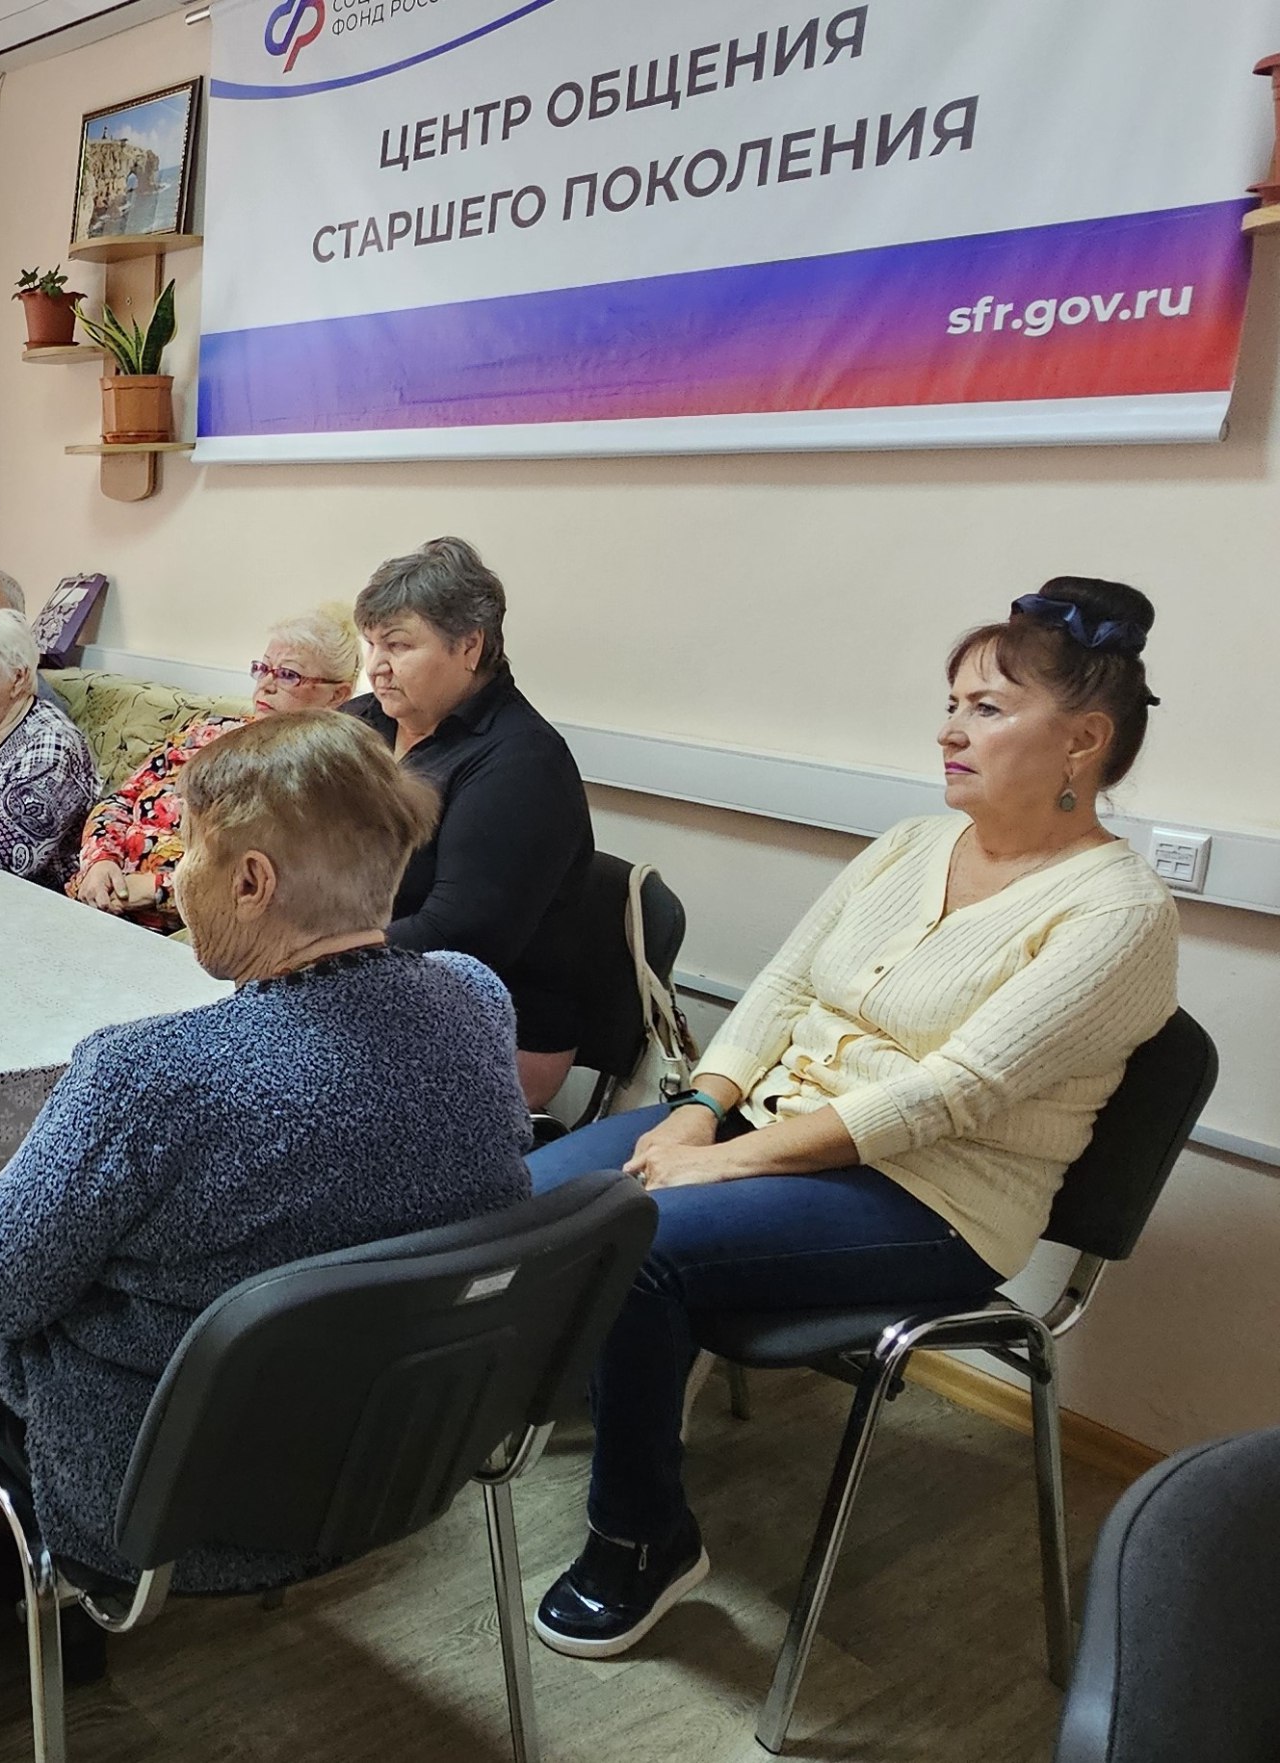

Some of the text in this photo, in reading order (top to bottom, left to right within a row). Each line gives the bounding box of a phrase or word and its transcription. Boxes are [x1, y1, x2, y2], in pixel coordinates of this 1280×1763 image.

[331, 4, 385, 36] ФОНД
[379, 4, 869, 172] ЦЕНТР ОБЩЕНИЯ
[312, 95, 980, 263] СТАРШЕГО ПОКОЛЕНИЯ
[946, 285, 1194, 337] sfr.gov.ru
